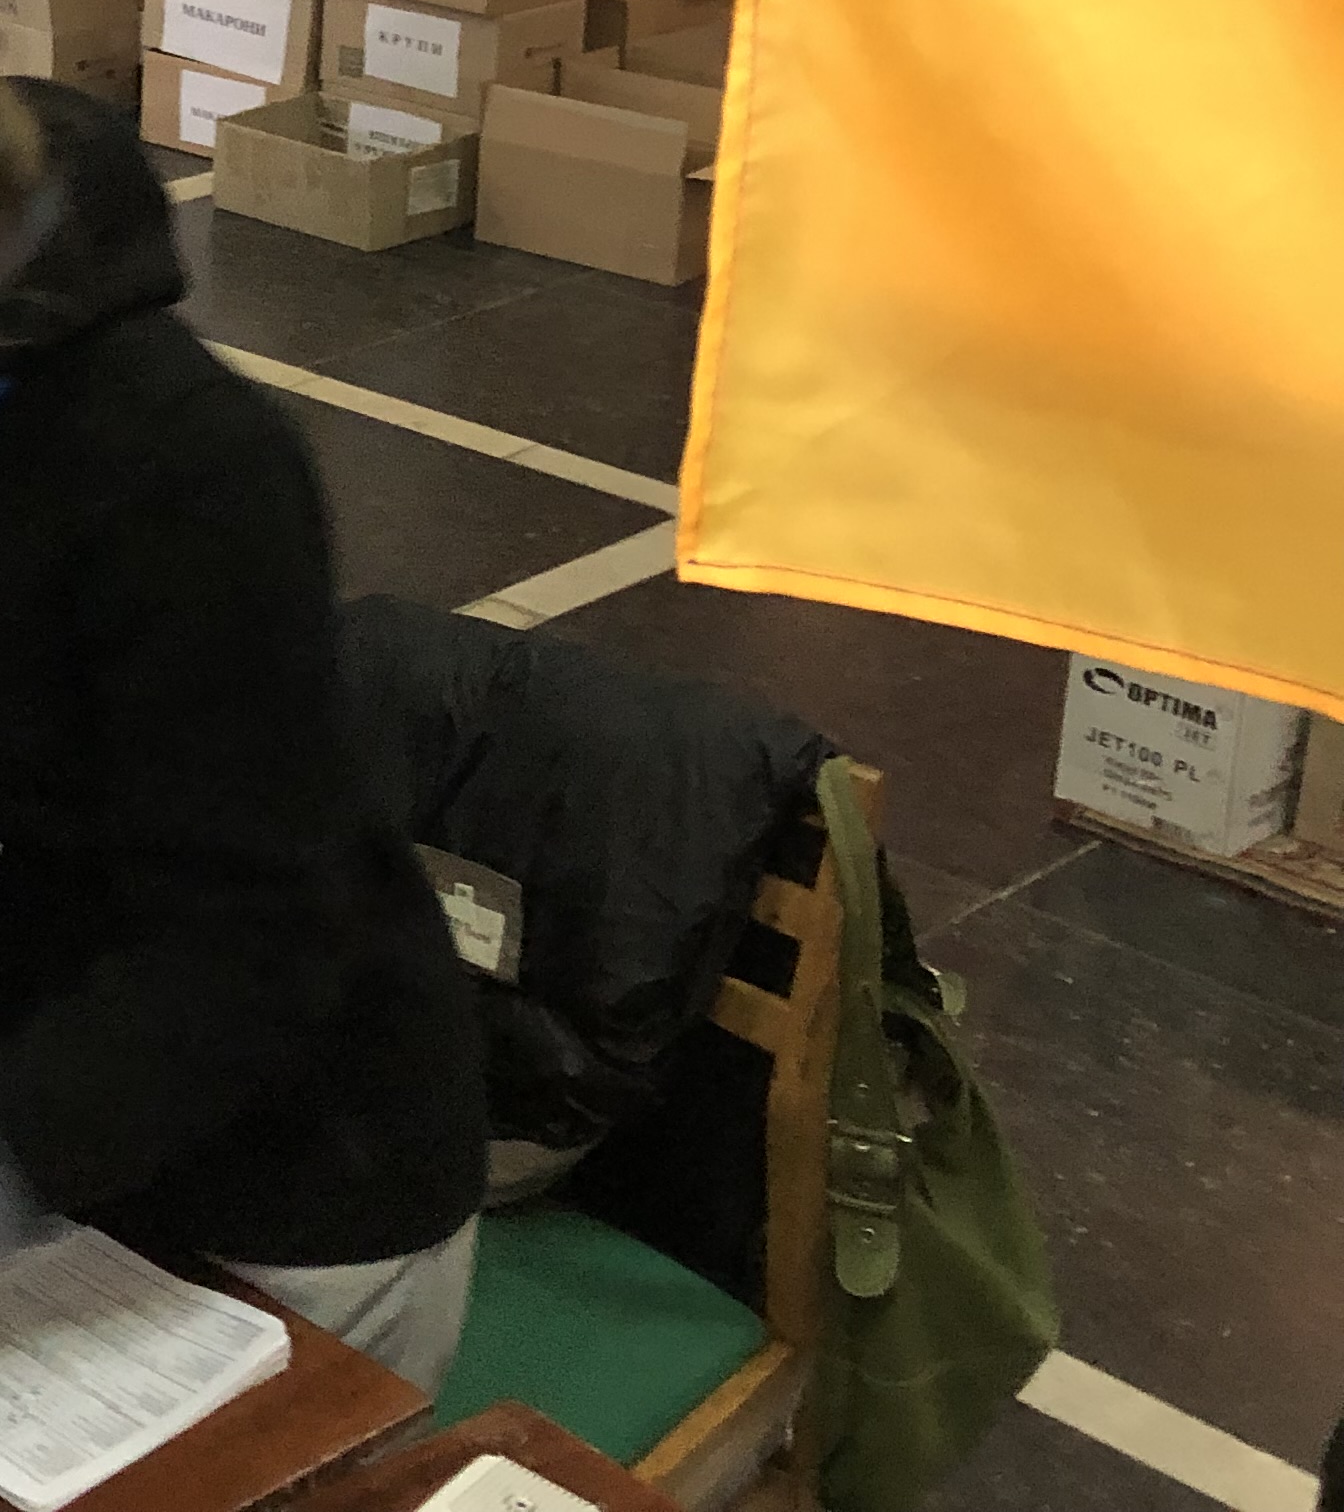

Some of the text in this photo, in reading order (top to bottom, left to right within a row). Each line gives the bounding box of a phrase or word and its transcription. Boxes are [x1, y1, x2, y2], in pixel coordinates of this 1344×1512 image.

[181, 3, 267, 37] МАКАРОНИ
[1125, 680, 1218, 731] OPTIMA
[1082, 725, 1164, 768] JET100
[1172, 758, 1201, 783] PL
